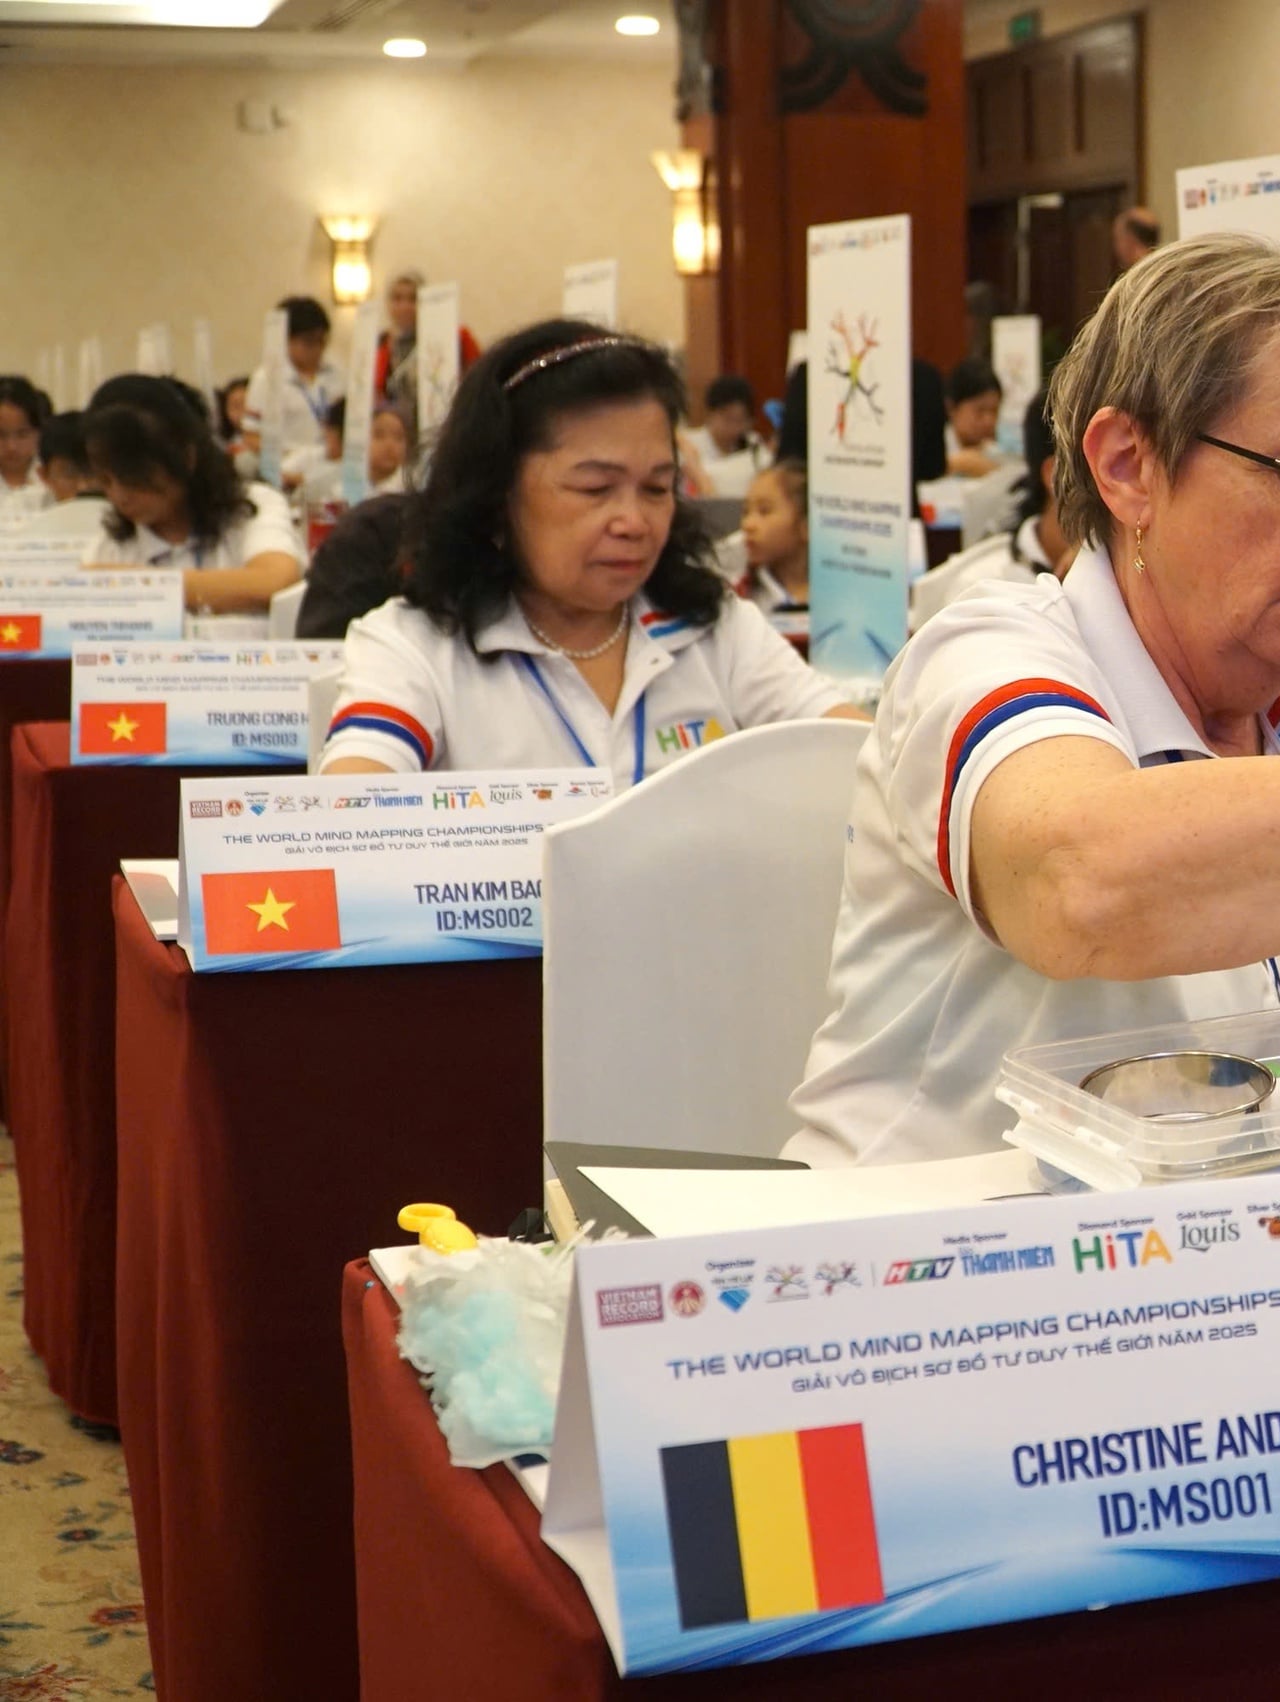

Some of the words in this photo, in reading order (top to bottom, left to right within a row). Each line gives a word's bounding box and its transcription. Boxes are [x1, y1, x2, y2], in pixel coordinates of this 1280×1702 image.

[433, 791, 485, 810] HiTA
[223, 835, 252, 844] THE
[257, 832, 311, 843] WORLD
[315, 831, 352, 841] MIND
[357, 828, 423, 840] MAPPING
[427, 824, 543, 837] CHAMPIONSHIPS
[414, 883, 469, 904] TRAN
[472, 881, 508, 901] KIM
[436, 907, 533, 931] ID:MS002
[1178, 1218, 1241, 1253] Louis
[1072, 1227, 1174, 1274] HiTA
[884, 1257, 955, 1286] HTV
[601, 1289, 657, 1305] VIETNAM
[602, 1300, 658, 1316] RECORD
[667, 1356, 726, 1380] THE
[734, 1343, 841, 1372] WORLD
[850, 1332, 921, 1359] MIND
[930, 1316, 1058, 1350] MAPPING
[792, 1373, 831, 1393] GIẢI
[835, 1368, 866, 1387] VÔ
[872, 1366, 917, 1385] ĐỊCH
[923, 1359, 953, 1377] SƠ
[992, 1350, 1021, 1369] TƯ
[1027, 1347, 1068, 1364] DUY
[1159, 1330, 1203, 1347] NĂM
[1208, 1323, 1258, 1340] 2025
[1013, 1421, 1208, 1488] CHRISTINE
[1099, 1472, 1272, 1537] ID:MS001
